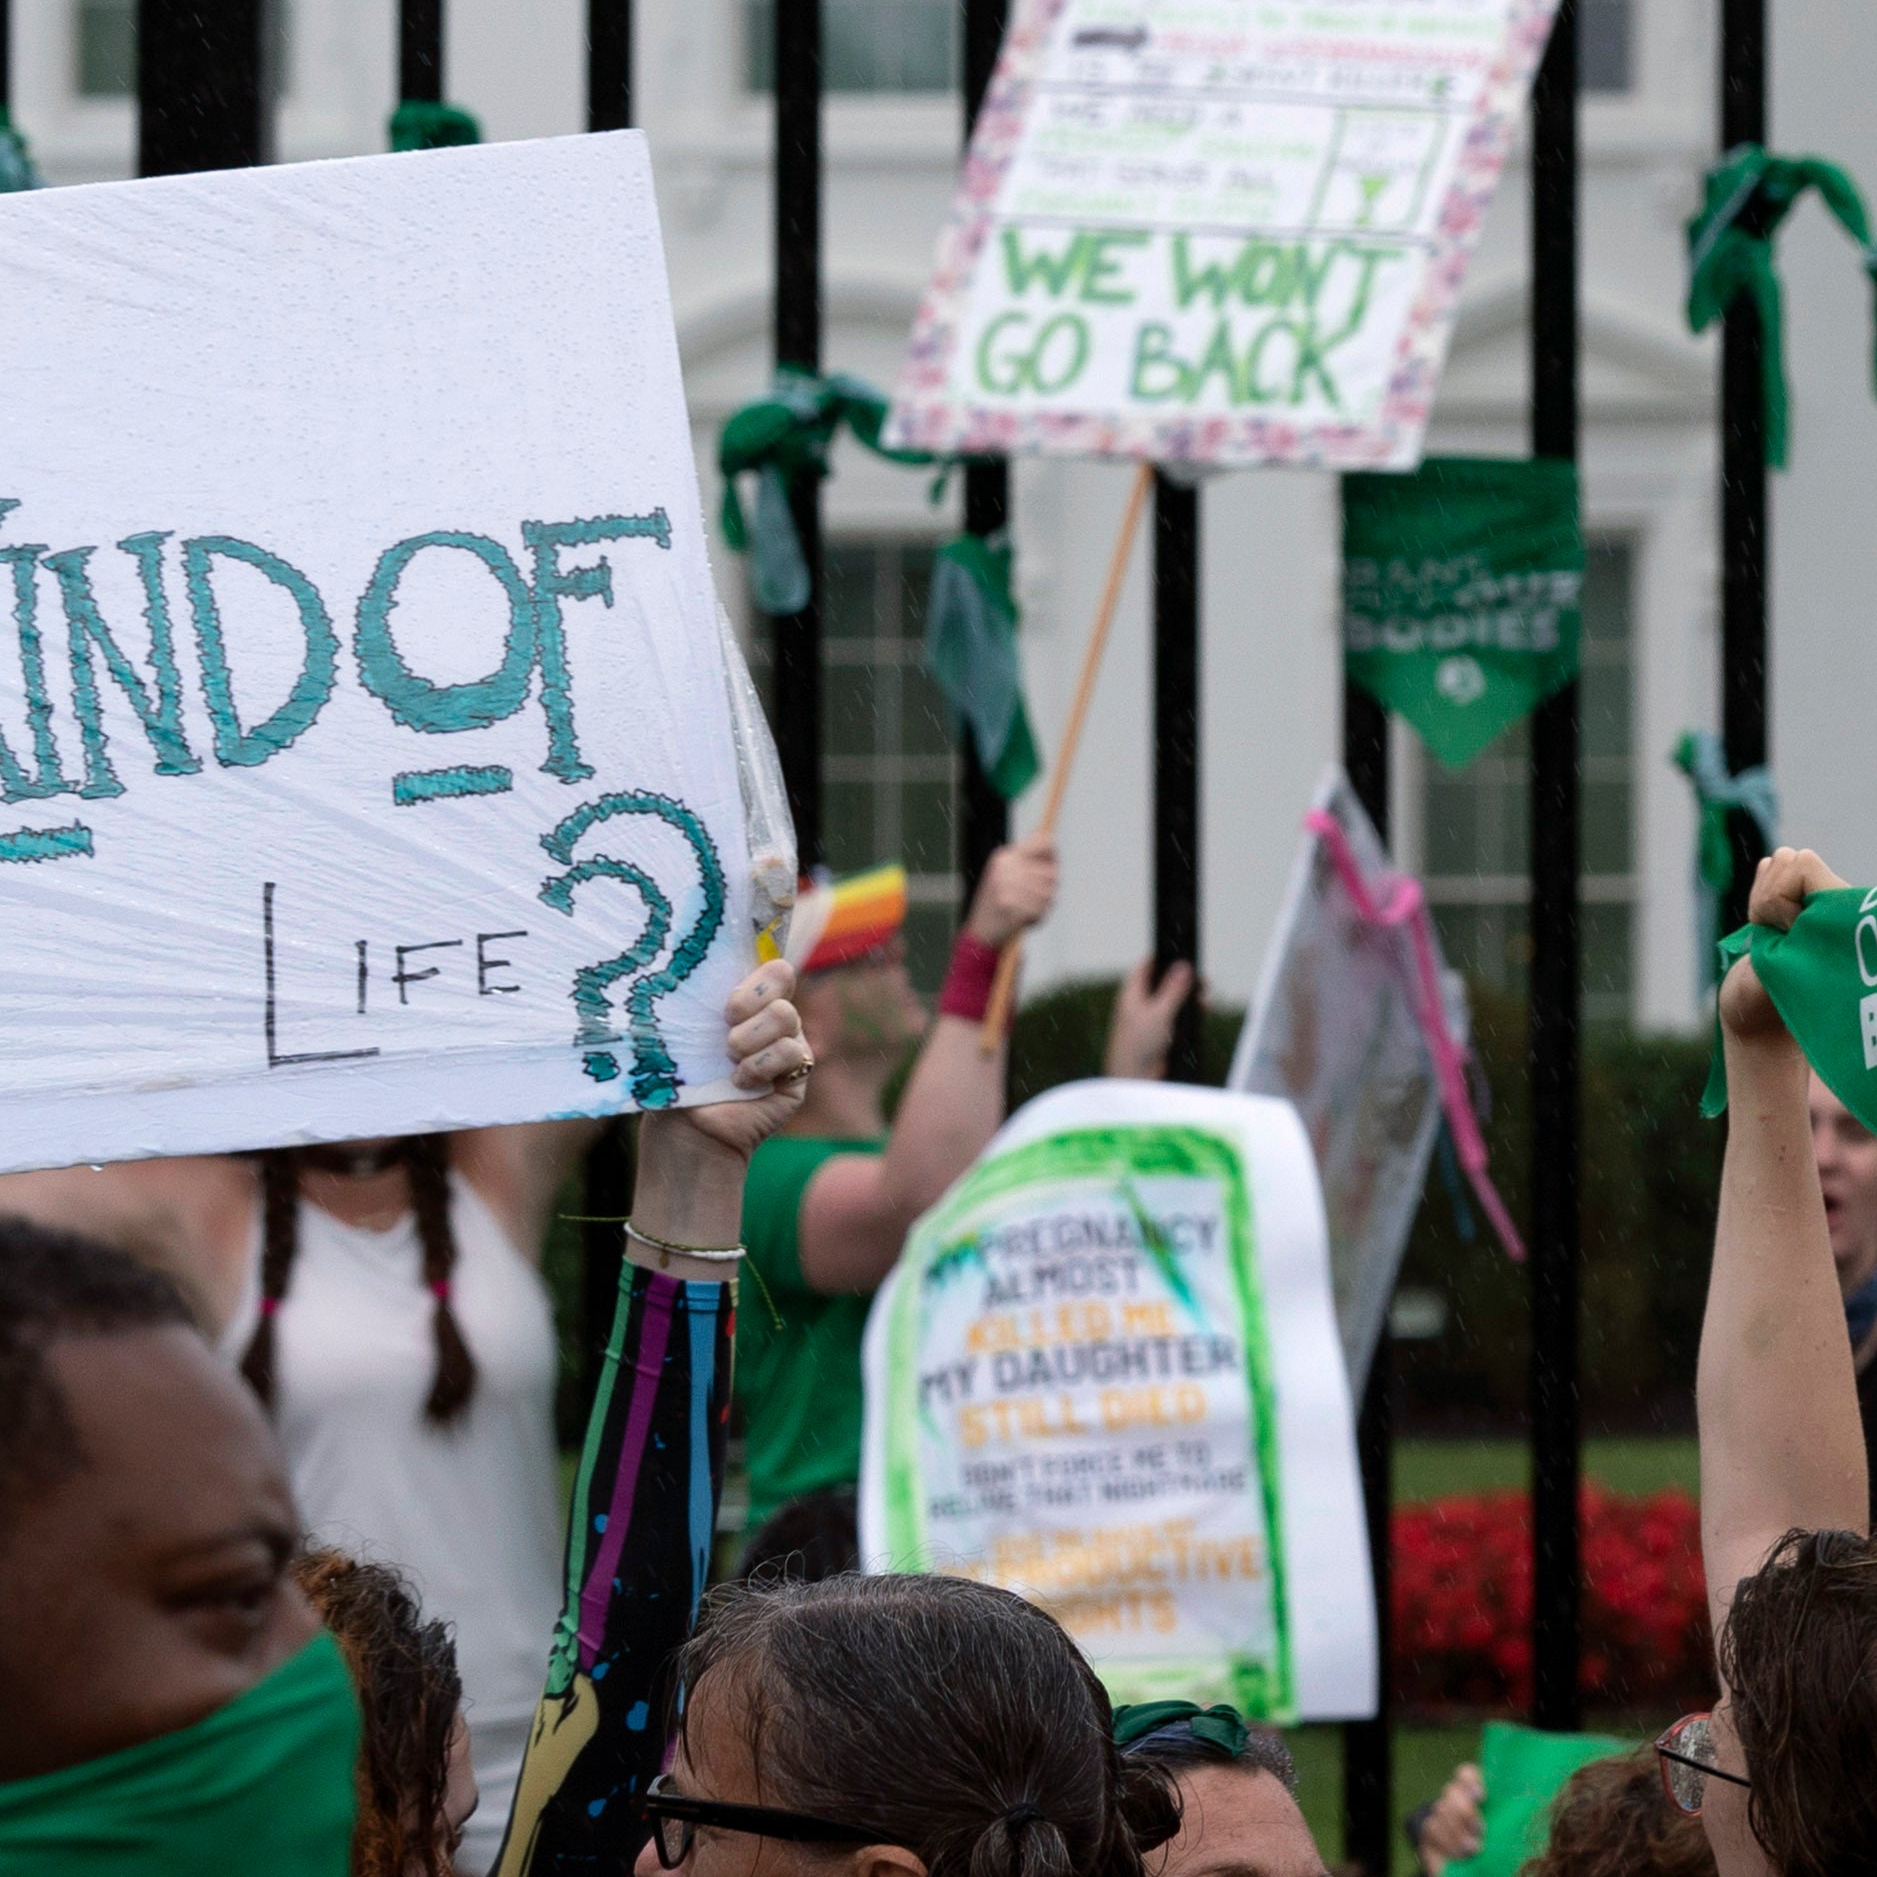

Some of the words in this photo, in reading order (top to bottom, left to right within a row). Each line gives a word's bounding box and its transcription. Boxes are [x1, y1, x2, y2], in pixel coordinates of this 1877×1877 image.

[1000, 228, 1149, 304] WE
[975, 310, 1091, 397] GO
[1128, 316, 1348, 410] BACK
[0, 530, 340, 805] IND
[354, 507, 672, 784] OF
[262, 881, 528, 1067] LIFE
[994, 1333, 1239, 1392] DAUGHTER
